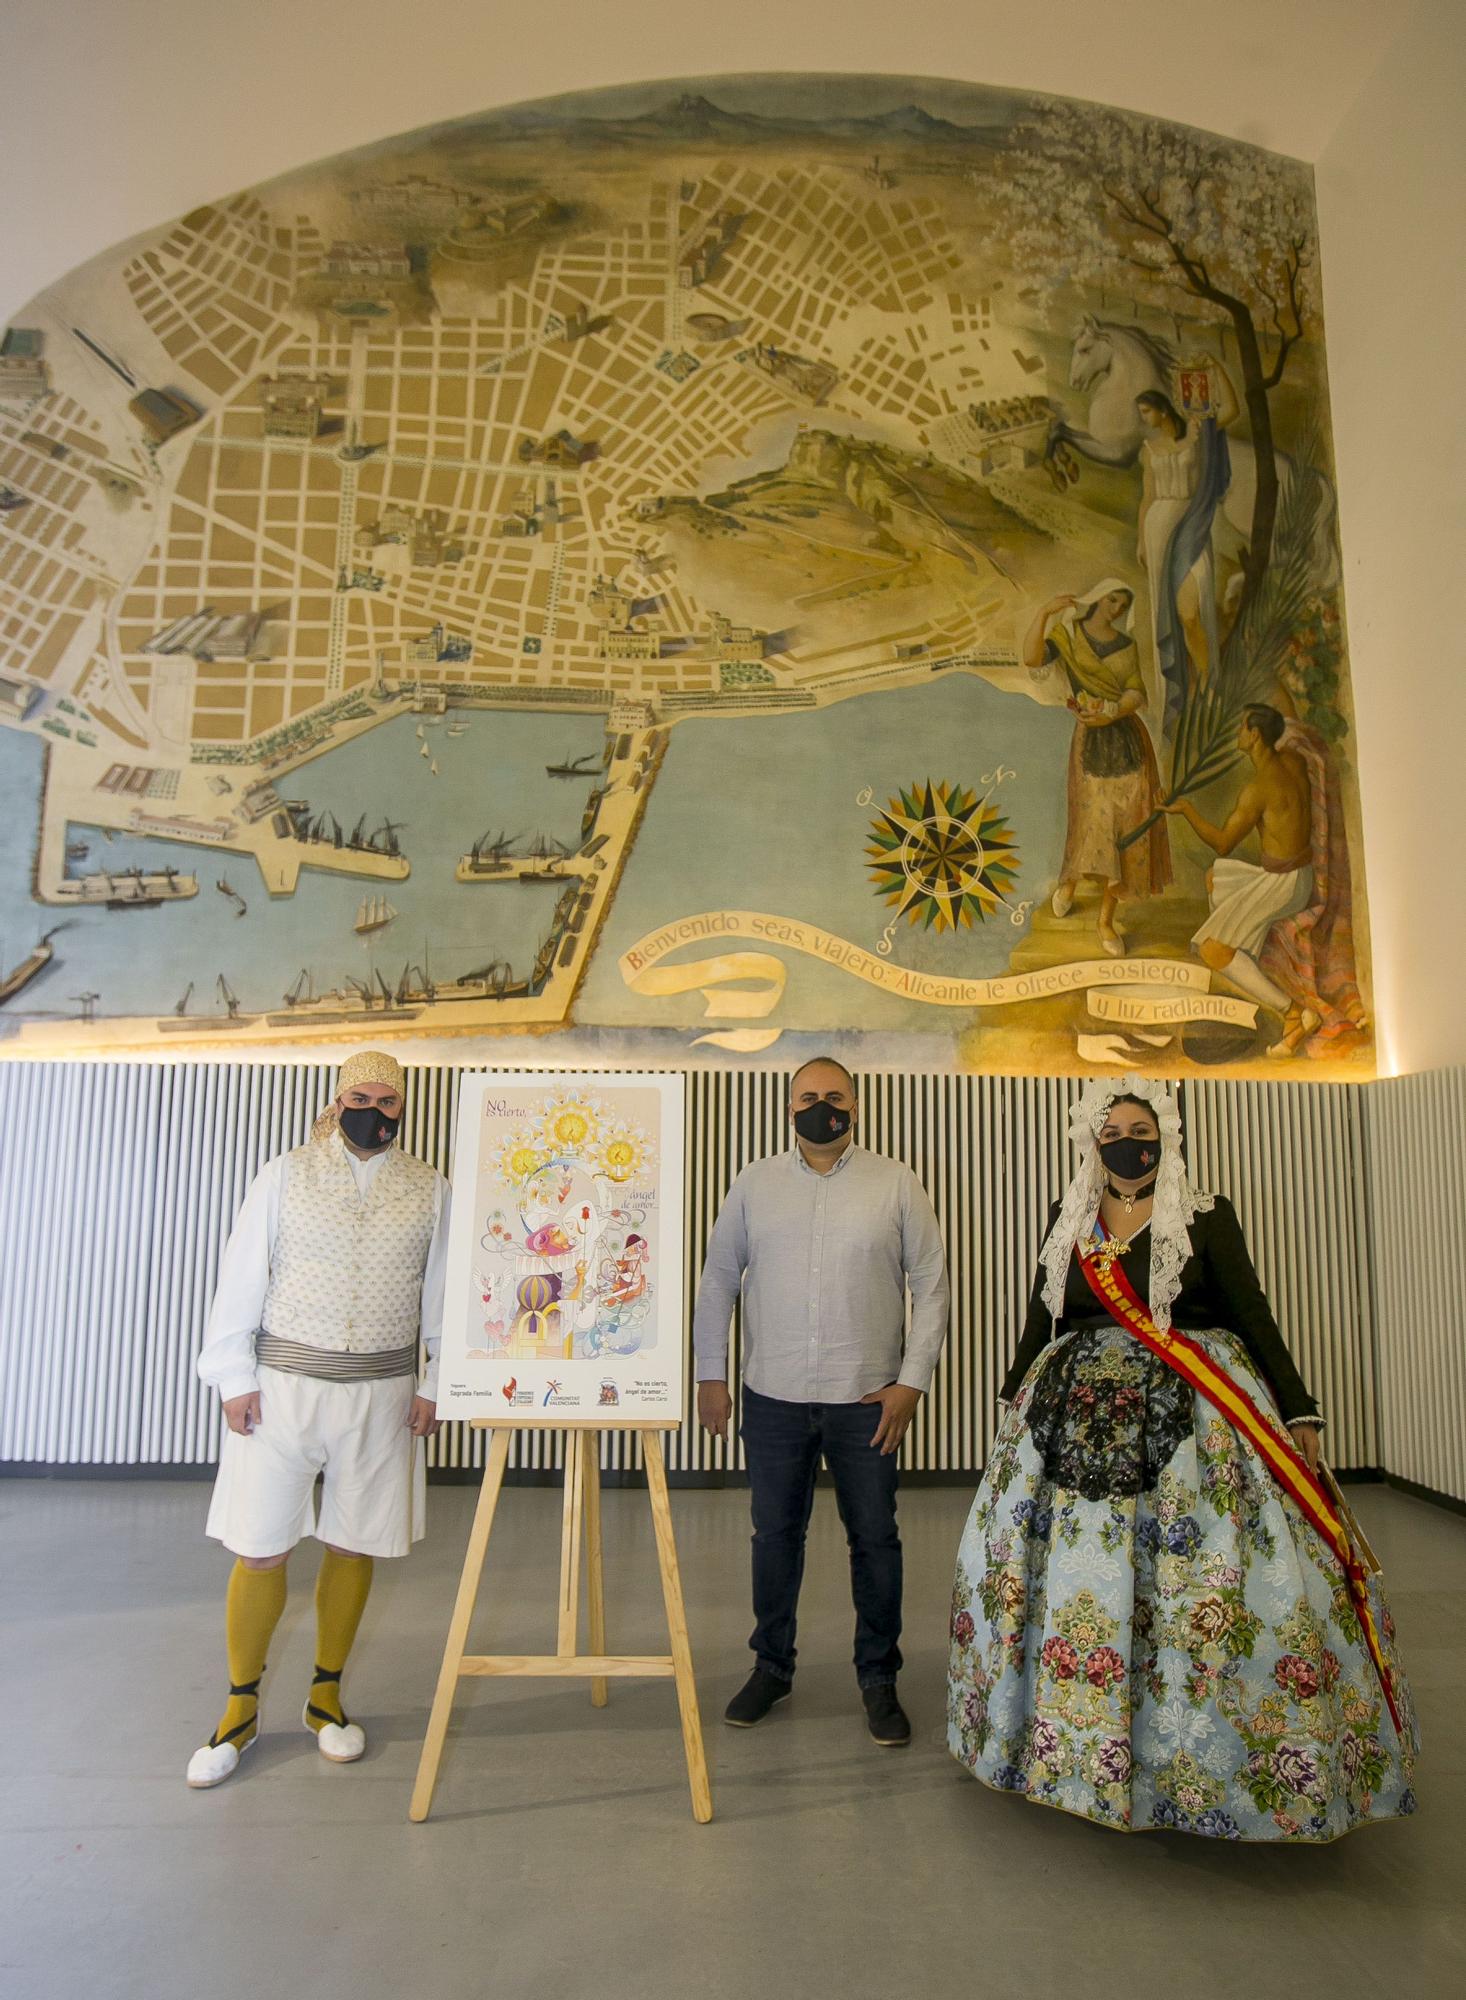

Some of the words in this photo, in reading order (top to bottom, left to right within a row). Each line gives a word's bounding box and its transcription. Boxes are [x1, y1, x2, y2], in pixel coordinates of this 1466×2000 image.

[875, 925, 898, 956] S
[625, 912, 740, 971] Bienvenido
[895, 971, 977, 1001] Alicante
[986, 982, 1006, 999] le
[1015, 968, 1083, 997] ofrece
[1098, 960, 1190, 984] sosiego
[1096, 997, 1109, 1017] y
[1117, 999, 1146, 1020] luz
[1152, 997, 1238, 1020] radiante
[450, 1390, 472, 1398] Sagrada
